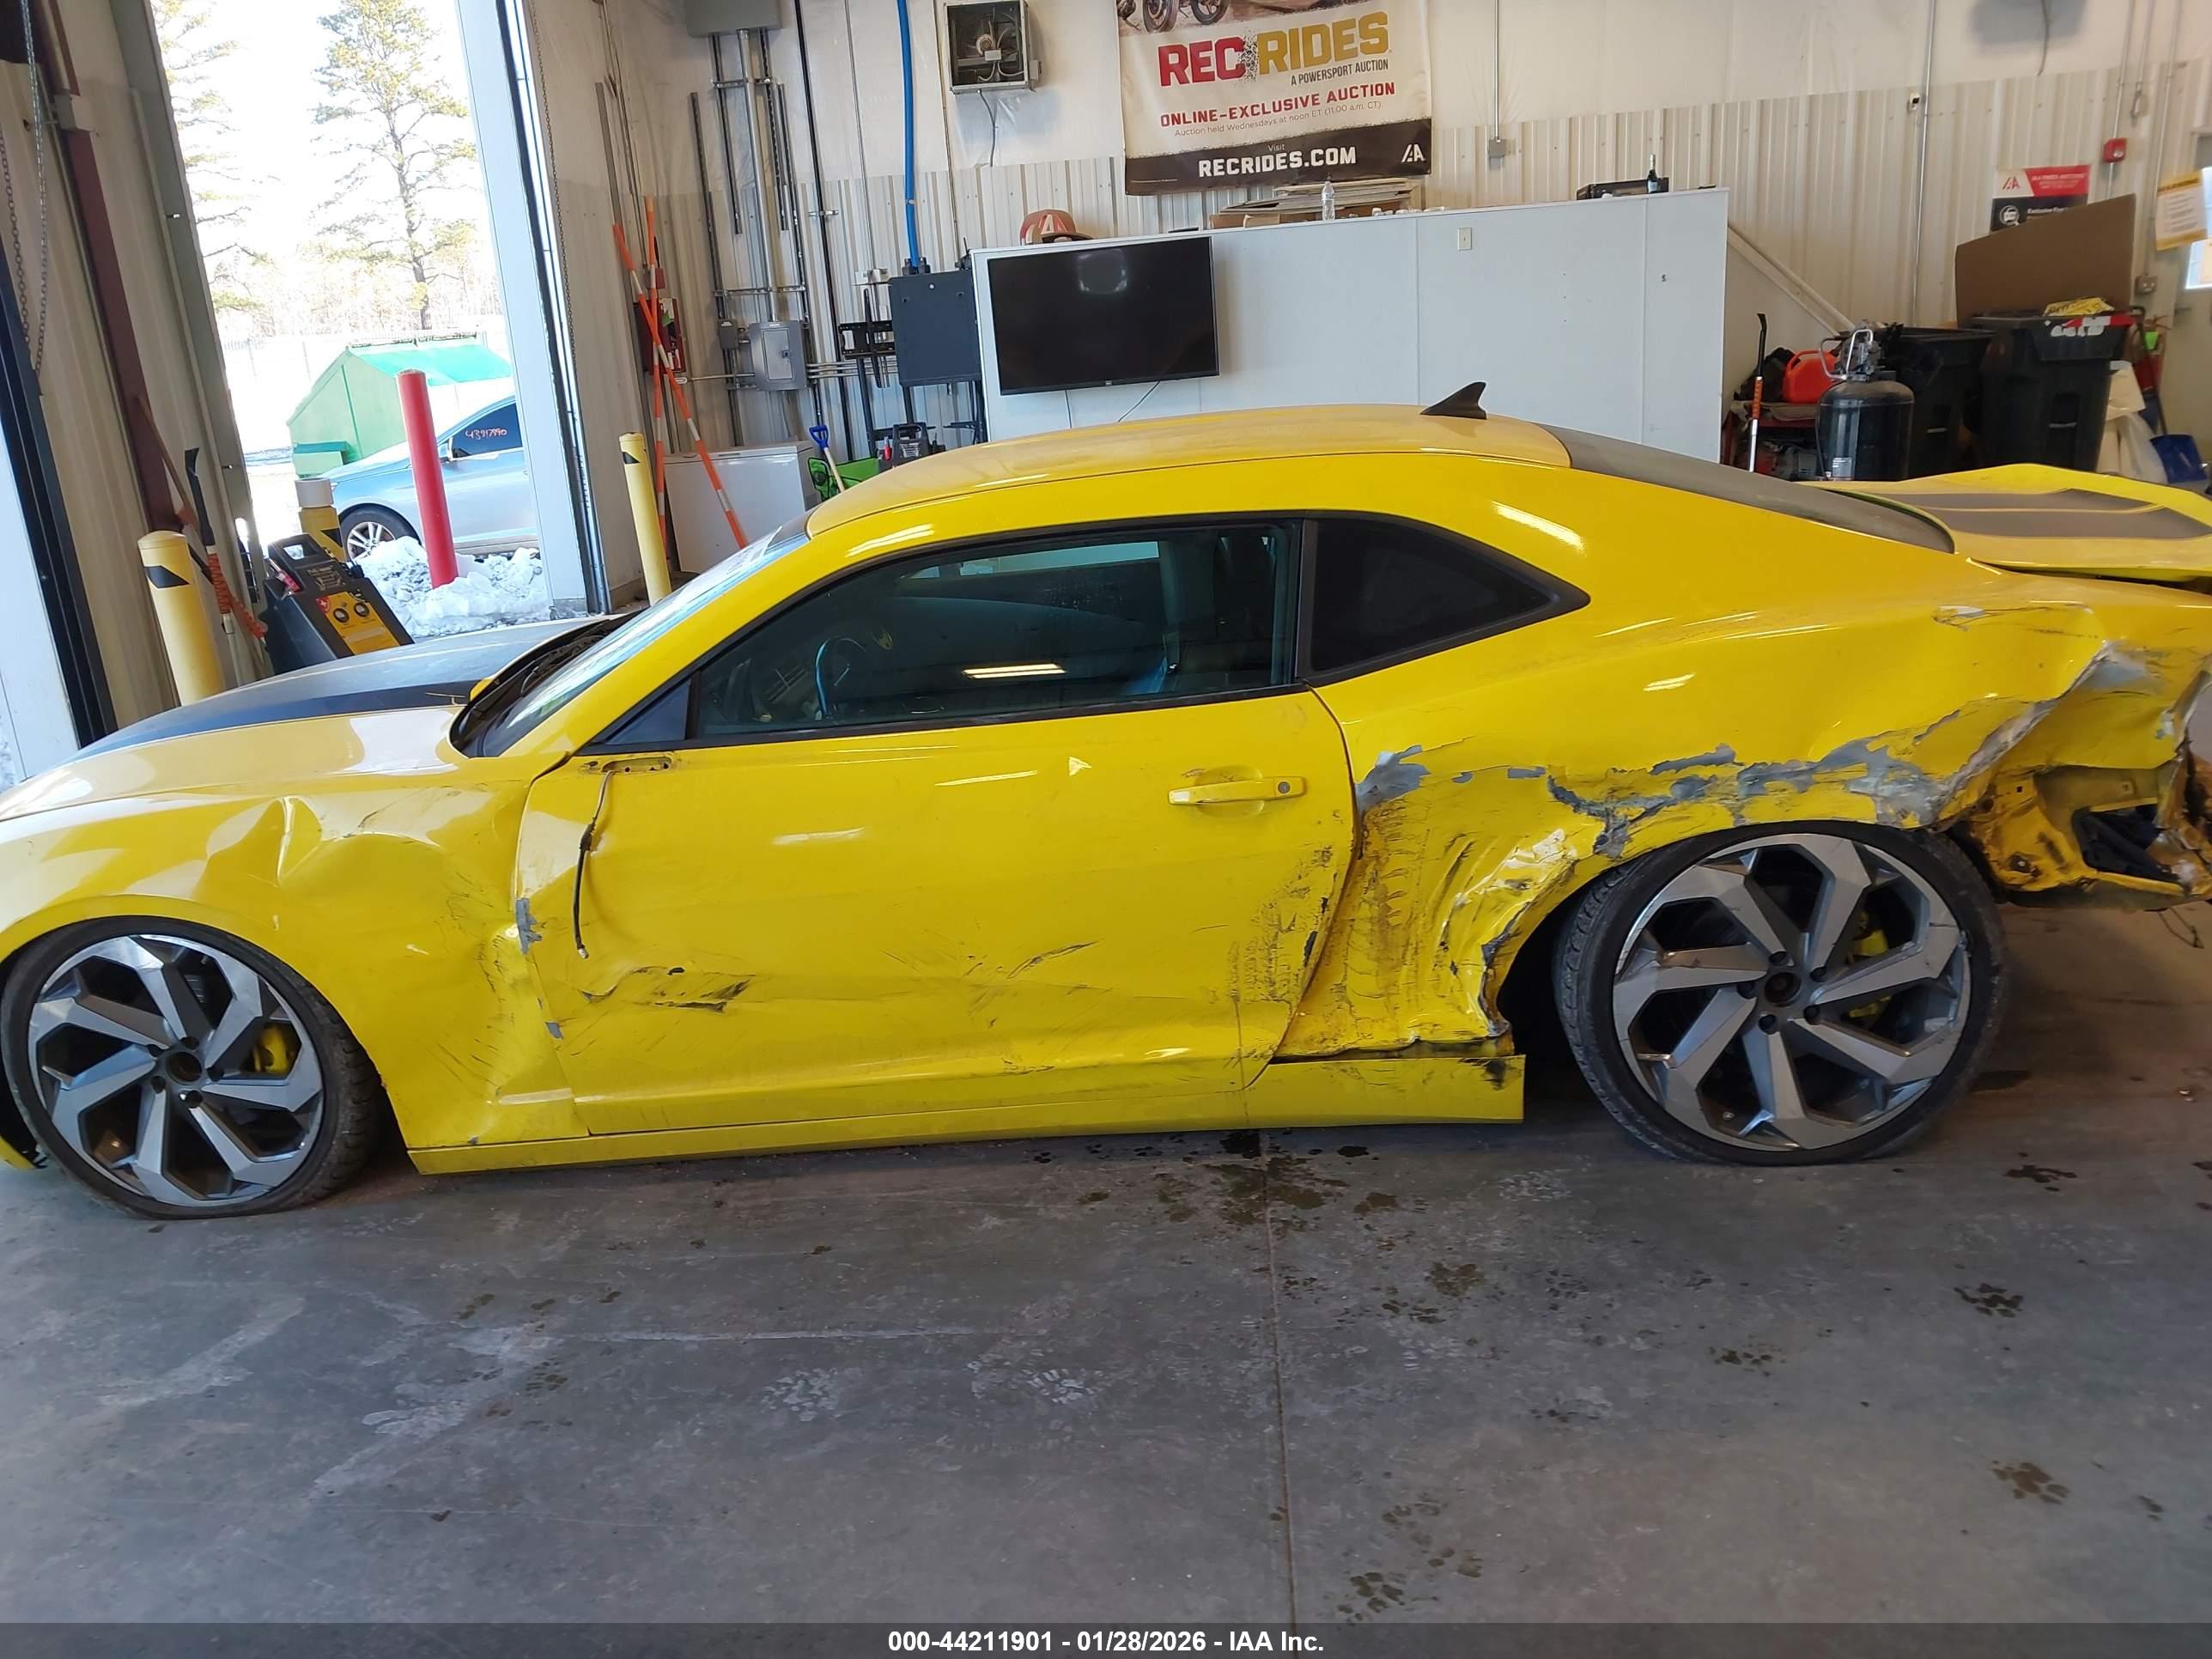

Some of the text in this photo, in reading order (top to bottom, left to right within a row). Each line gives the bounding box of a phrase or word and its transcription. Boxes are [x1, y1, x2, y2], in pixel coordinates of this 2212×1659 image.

[1158, 11, 1389, 87] REC RIDES
[1291, 58, 1389, 86] A POWERSPORT AUCTION
[1160, 82, 1395, 127] ONLINE-EXCLUSIVE AUCTION
[1175, 127, 1206, 137] Auction
[1207, 125, 1224, 133] held
[1227, 118, 1277, 131] Wednesdays
[1289, 112, 1310, 121] noon
[1367, 100, 1382, 109] CT)
[1199, 147, 1357, 178] RECRIDES.COM
[1268, 143, 1285, 152] Visit
